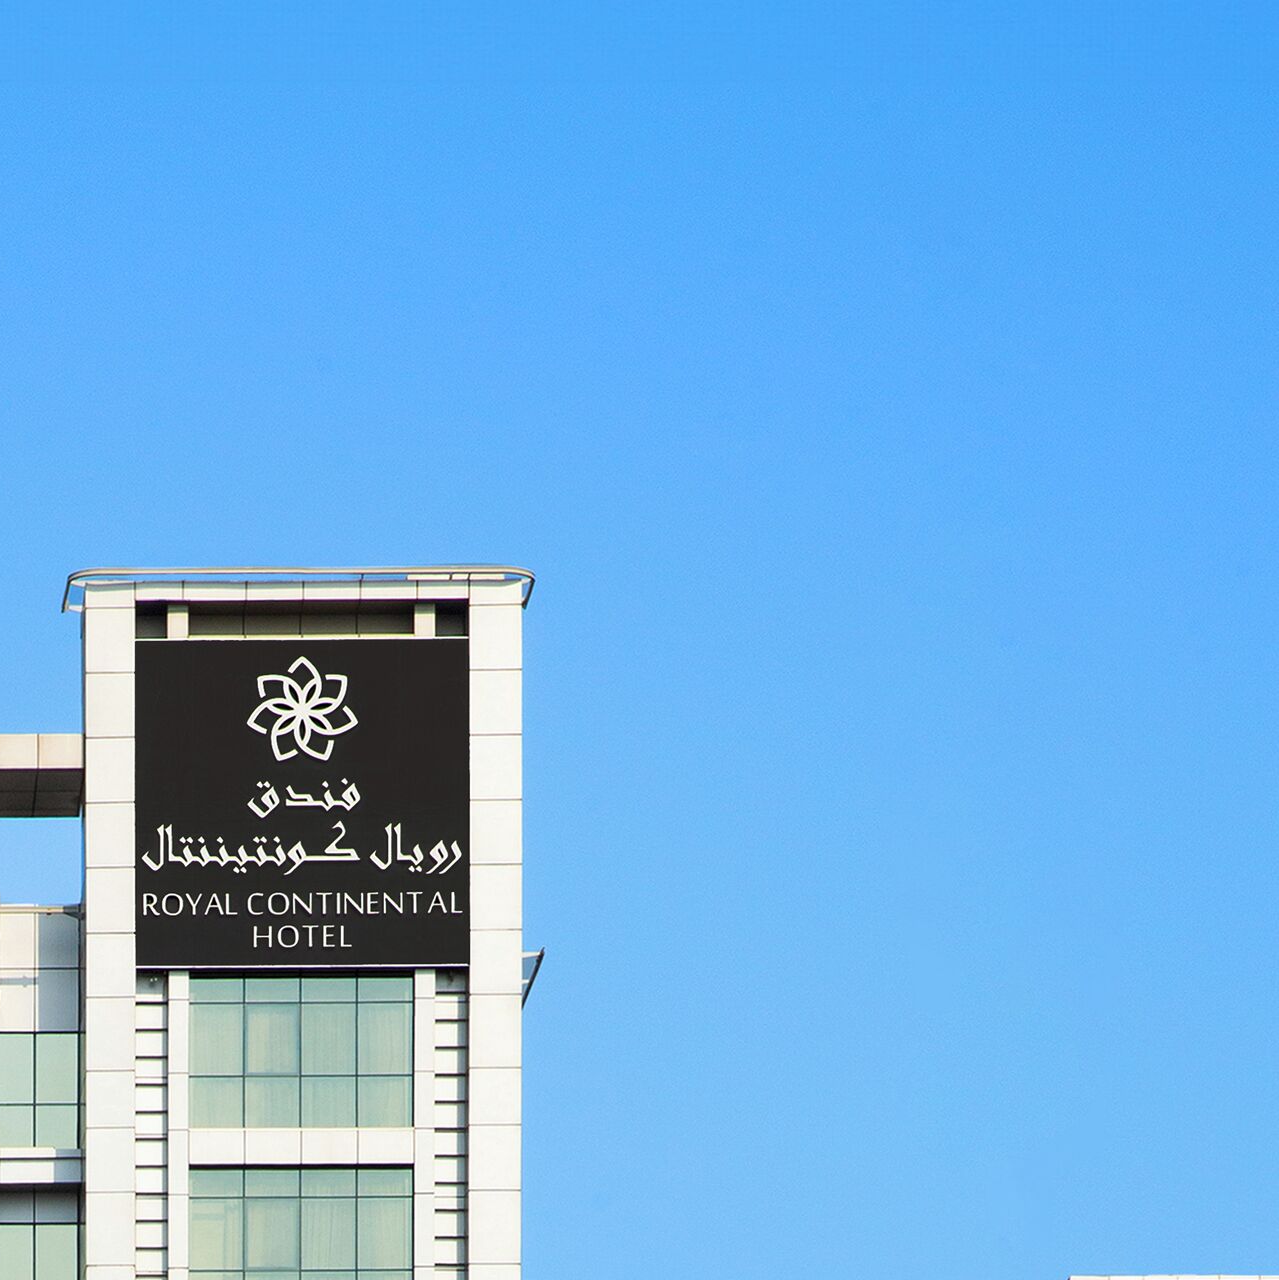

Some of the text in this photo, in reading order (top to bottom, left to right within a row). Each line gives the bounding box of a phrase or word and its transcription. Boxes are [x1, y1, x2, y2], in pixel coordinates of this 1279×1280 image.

[247, 778, 361, 819] فندق
[141, 820, 463, 876] رويال كونتيننتال
[142, 891, 464, 916] ROYAL CONTINENTAL
[253, 924, 353, 948] HOTEL
